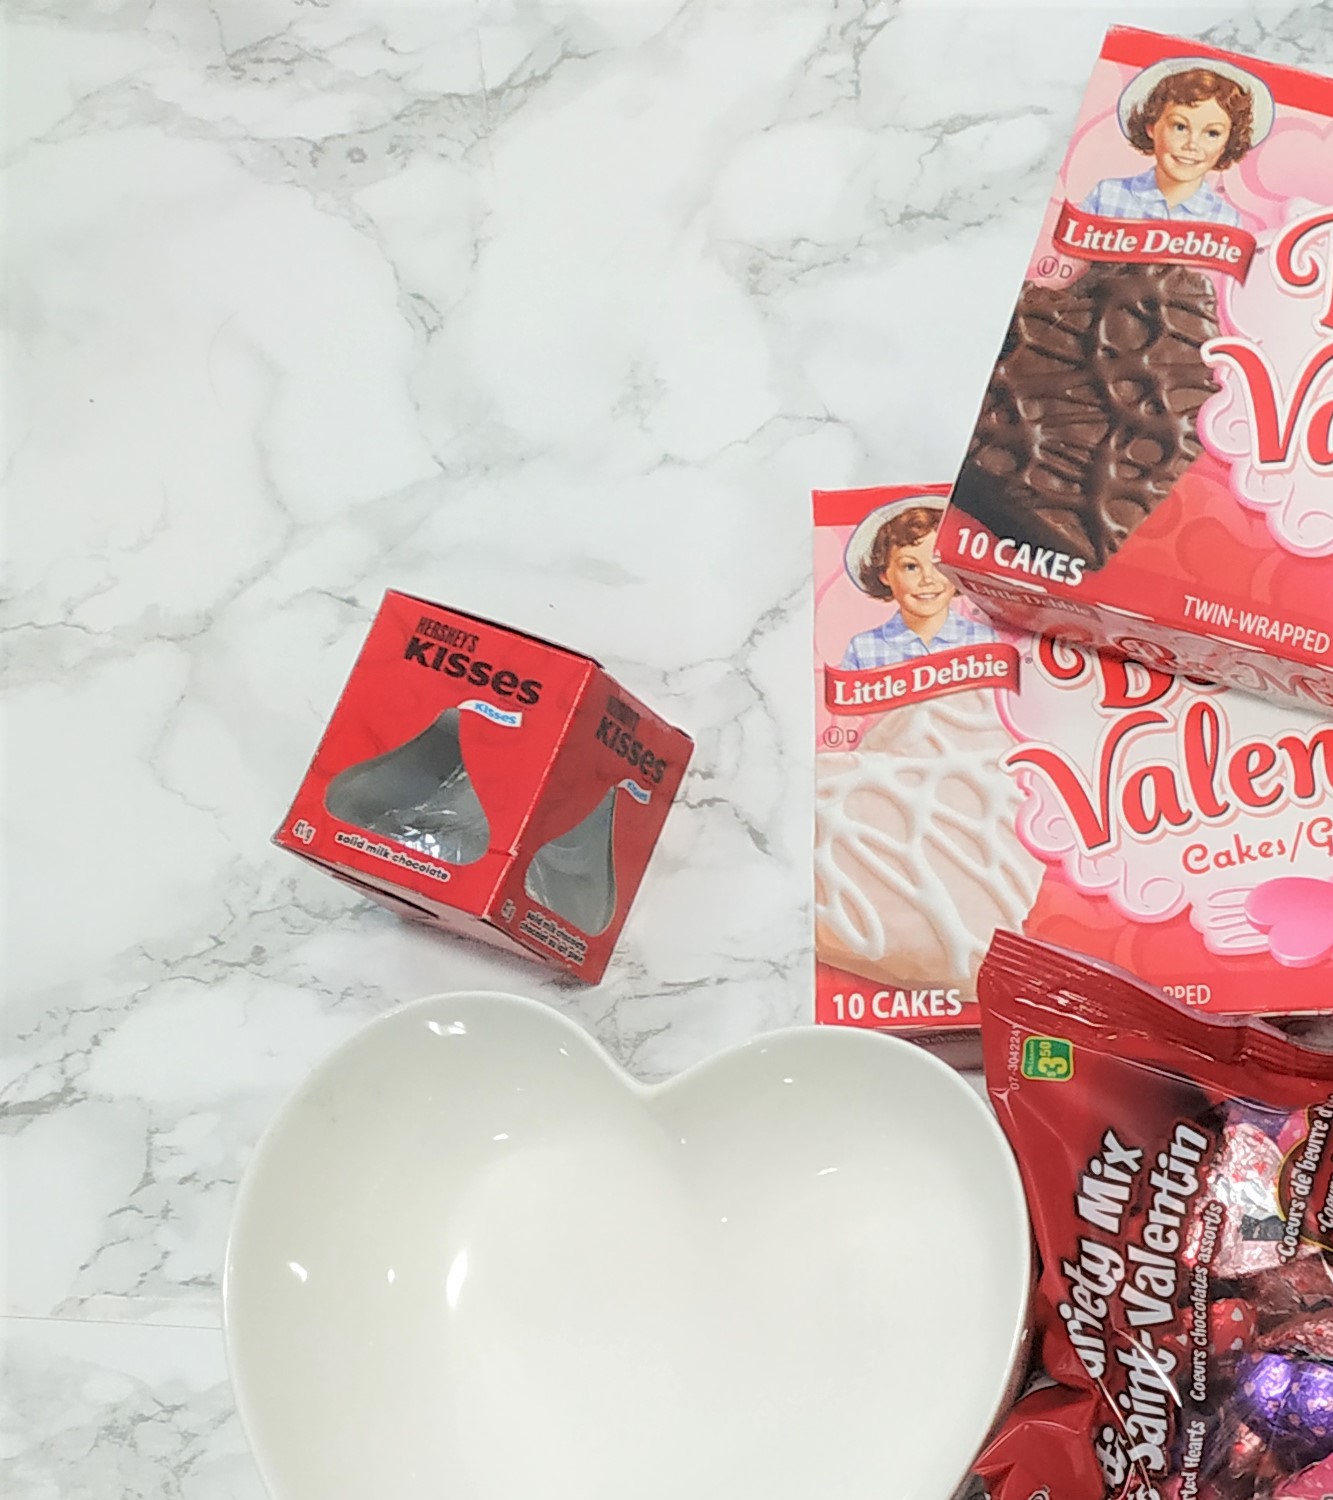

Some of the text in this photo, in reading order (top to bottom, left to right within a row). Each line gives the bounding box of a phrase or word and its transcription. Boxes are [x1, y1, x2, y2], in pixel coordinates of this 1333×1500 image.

[1061, 220, 1243, 264] Little Debbie
[956, 528, 1088, 587] 10 CAKES
[1182, 594, 1331, 655] TWIN-WRAPPED
[833, 655, 1010, 706] Little Debbie
[336, 833, 449, 882] solid milk chocolate
[832, 988, 962, 1020] 10 CAKES
[1077, 1129, 1143, 1235] Mix
[1278, 1197, 1306, 1257] Coeurs
[1295, 1118, 1329, 1173] beurre
[1116, 1124, 1208, 1472] Saint-Valentin
[1189, 1201, 1223, 1402] Coeurs chocolates assortis
[1183, 1420, 1206, 1468] Hearts
